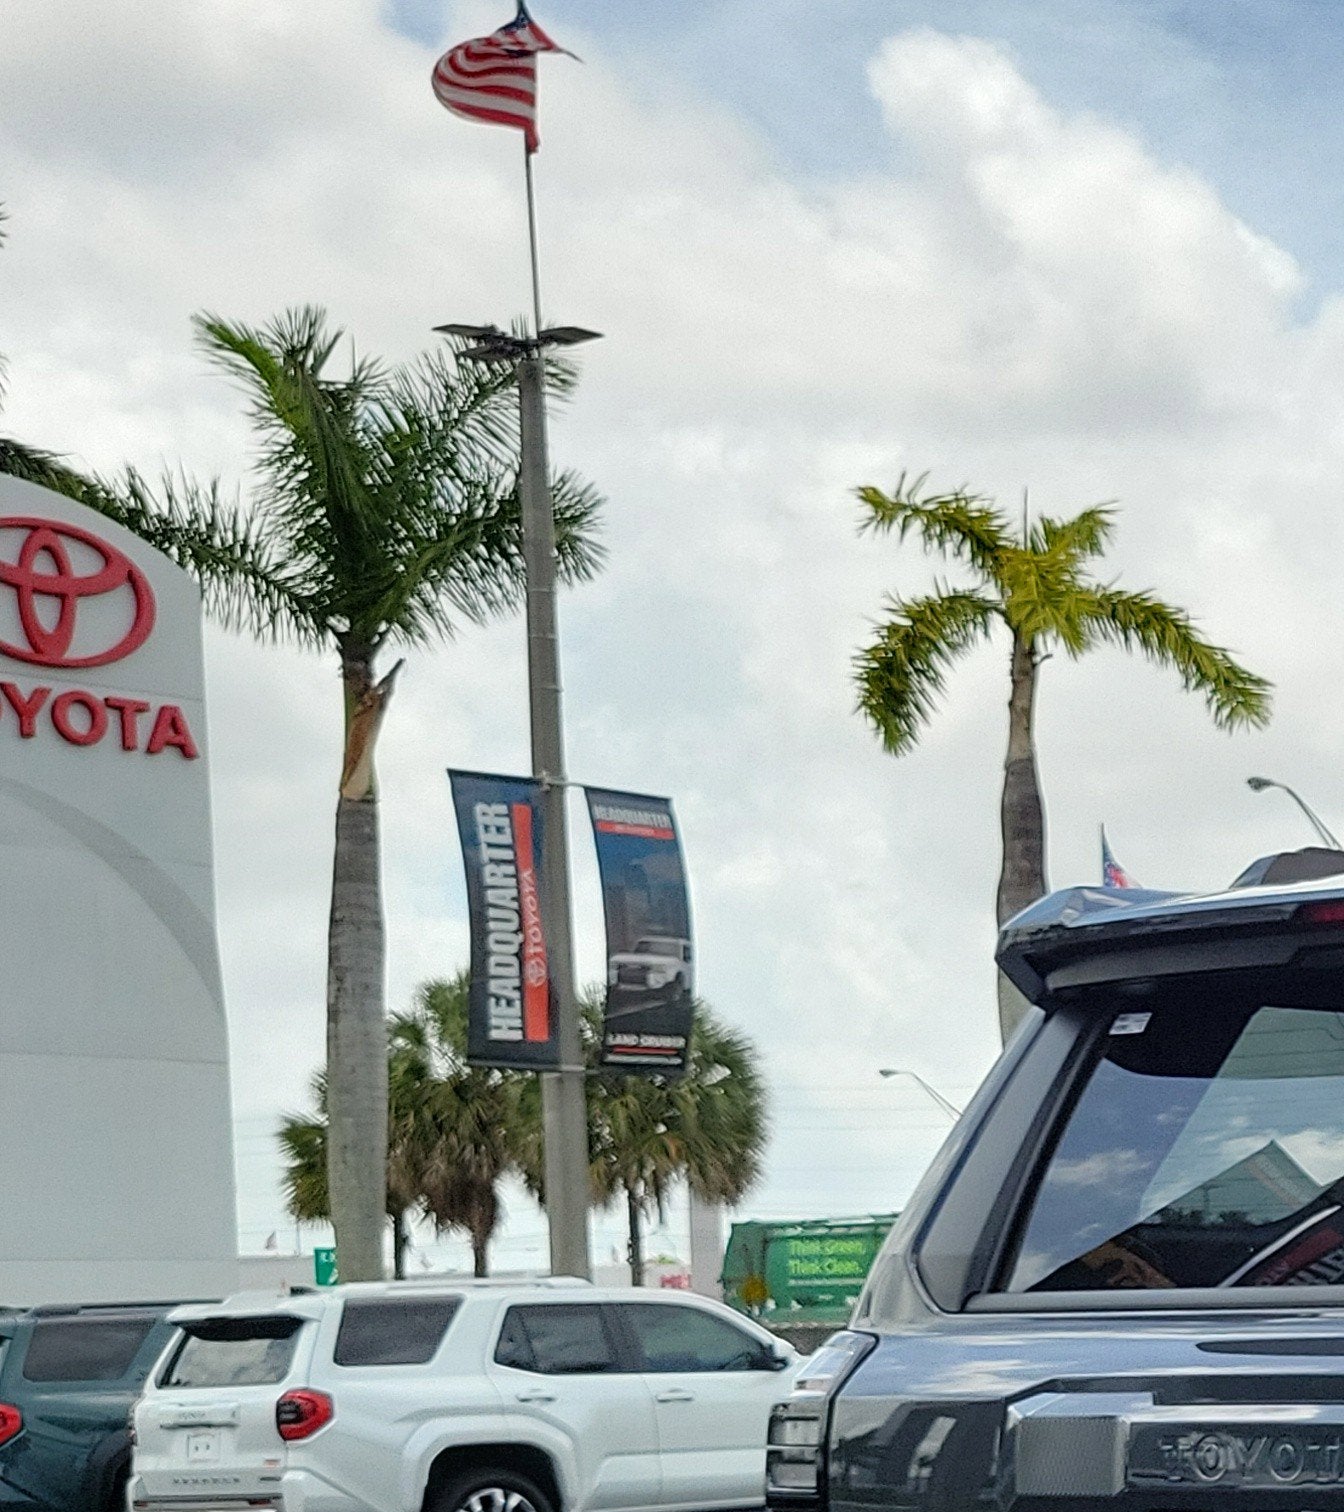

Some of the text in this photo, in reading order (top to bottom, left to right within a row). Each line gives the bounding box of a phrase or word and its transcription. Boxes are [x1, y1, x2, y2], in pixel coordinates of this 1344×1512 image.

[0, 681, 199, 760] YOTA
[473, 801, 525, 1042] HEADQUARTER
[518, 868, 544, 954] TOYOTA
